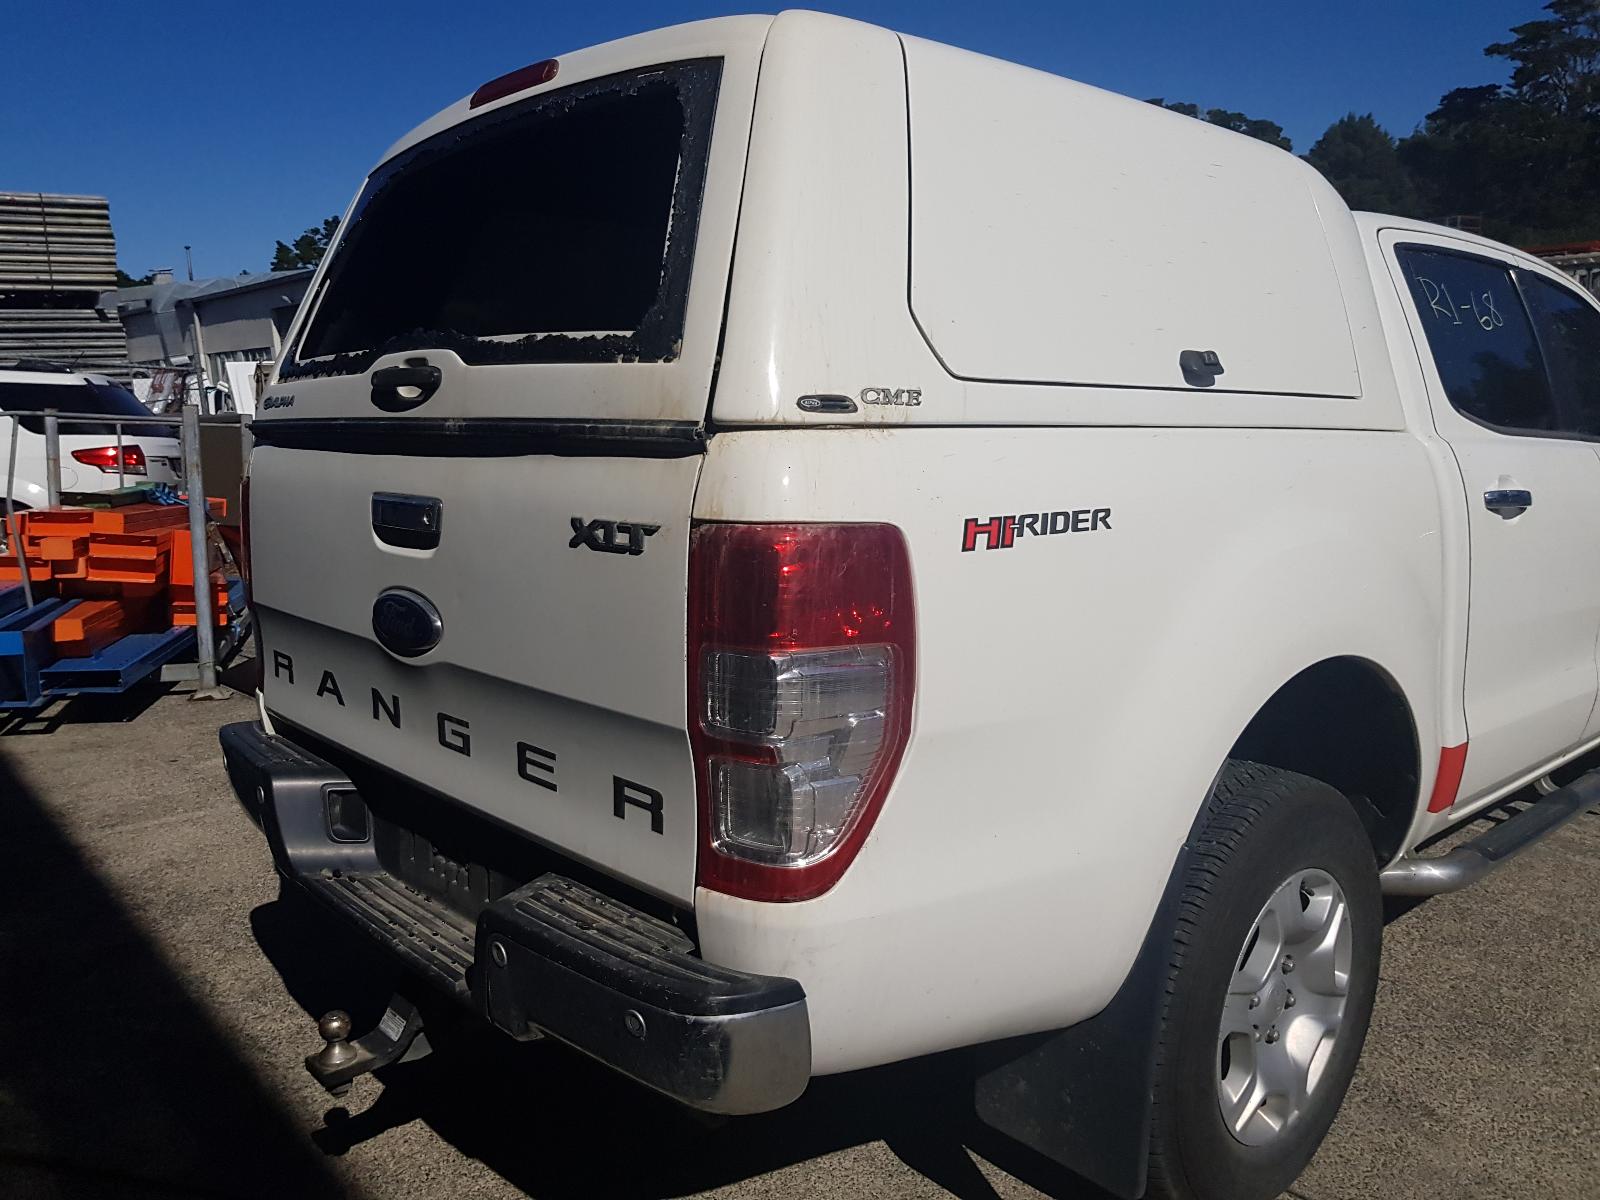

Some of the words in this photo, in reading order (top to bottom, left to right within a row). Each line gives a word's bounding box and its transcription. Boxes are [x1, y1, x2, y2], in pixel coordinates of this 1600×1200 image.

[861, 388, 922, 406] CME
[569, 517, 661, 556] XLT
[273, 649, 664, 835] RANGER
